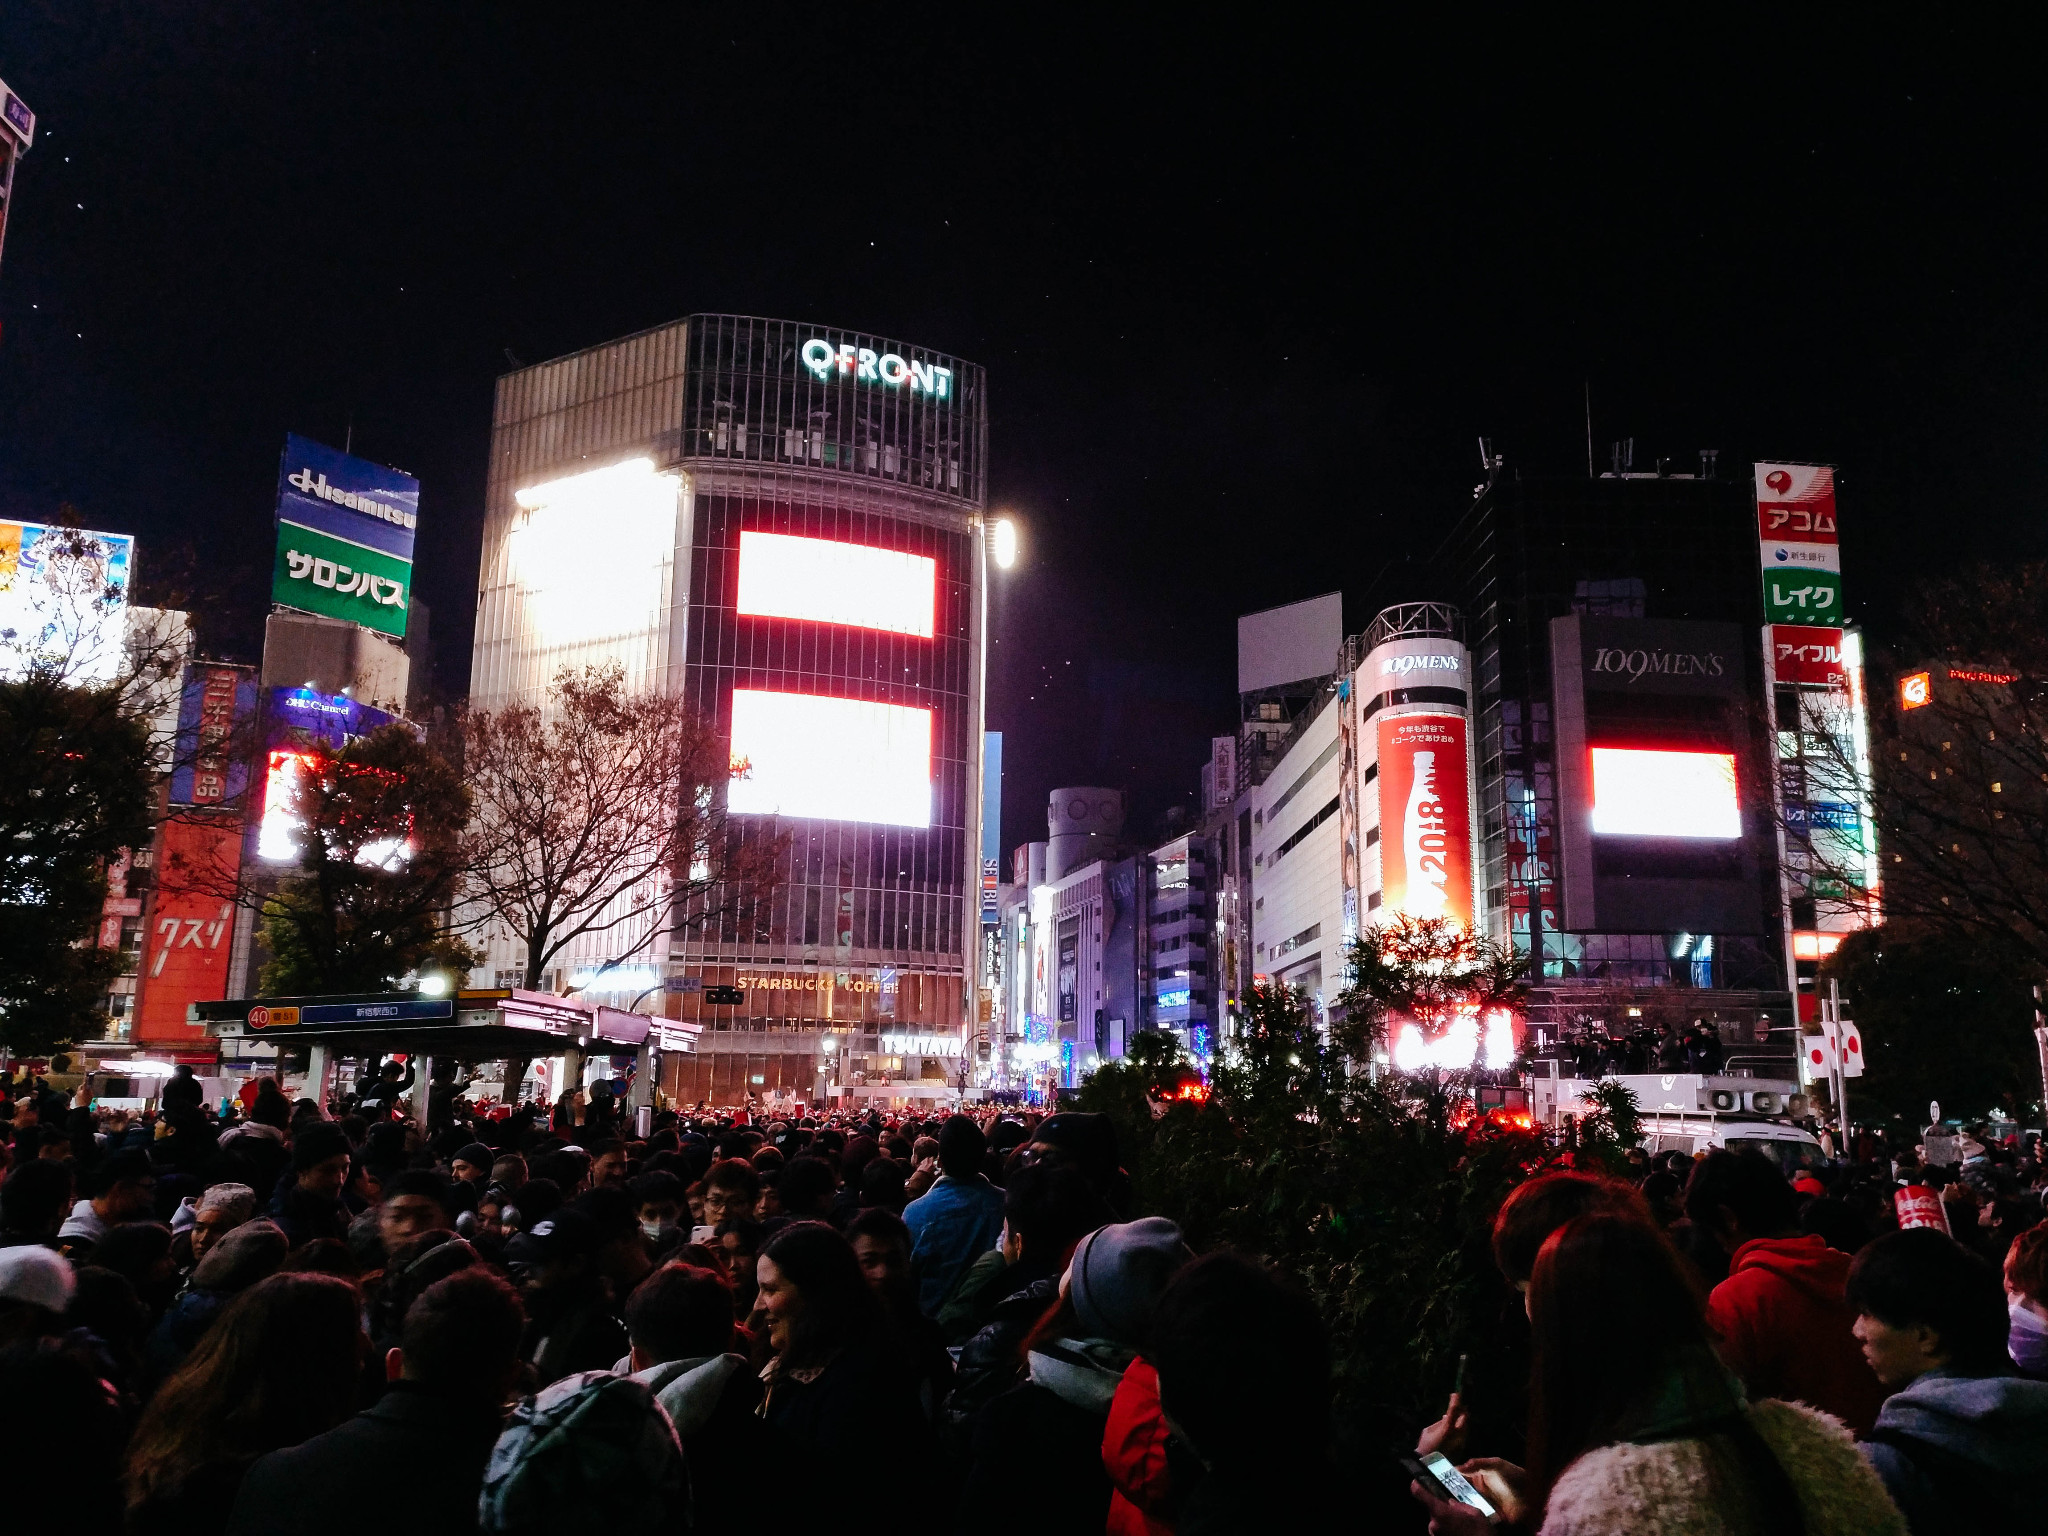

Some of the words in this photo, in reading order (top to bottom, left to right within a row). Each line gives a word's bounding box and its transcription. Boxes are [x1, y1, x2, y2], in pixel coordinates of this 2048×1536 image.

[288, 468, 417, 529] Hisamitsu
[1767, 508, 1836, 533] アコム
[1790, 551, 1826, 562] 新生銀行
[286, 549, 406, 610] サロンパス
[1772, 583, 1835, 608] レイク
[1776, 643, 1842, 664] アイフル
[1398, 724, 1446, 735] 今年も渋谷で
[150, 903, 233, 979] クスリ
[737, 976, 834, 992] STARBUCKS
[250, 1010, 268, 1024] 40
[356, 1006, 399, 1017] 新宿駅西口
[881, 1034, 961, 1056] TSUTAYA
